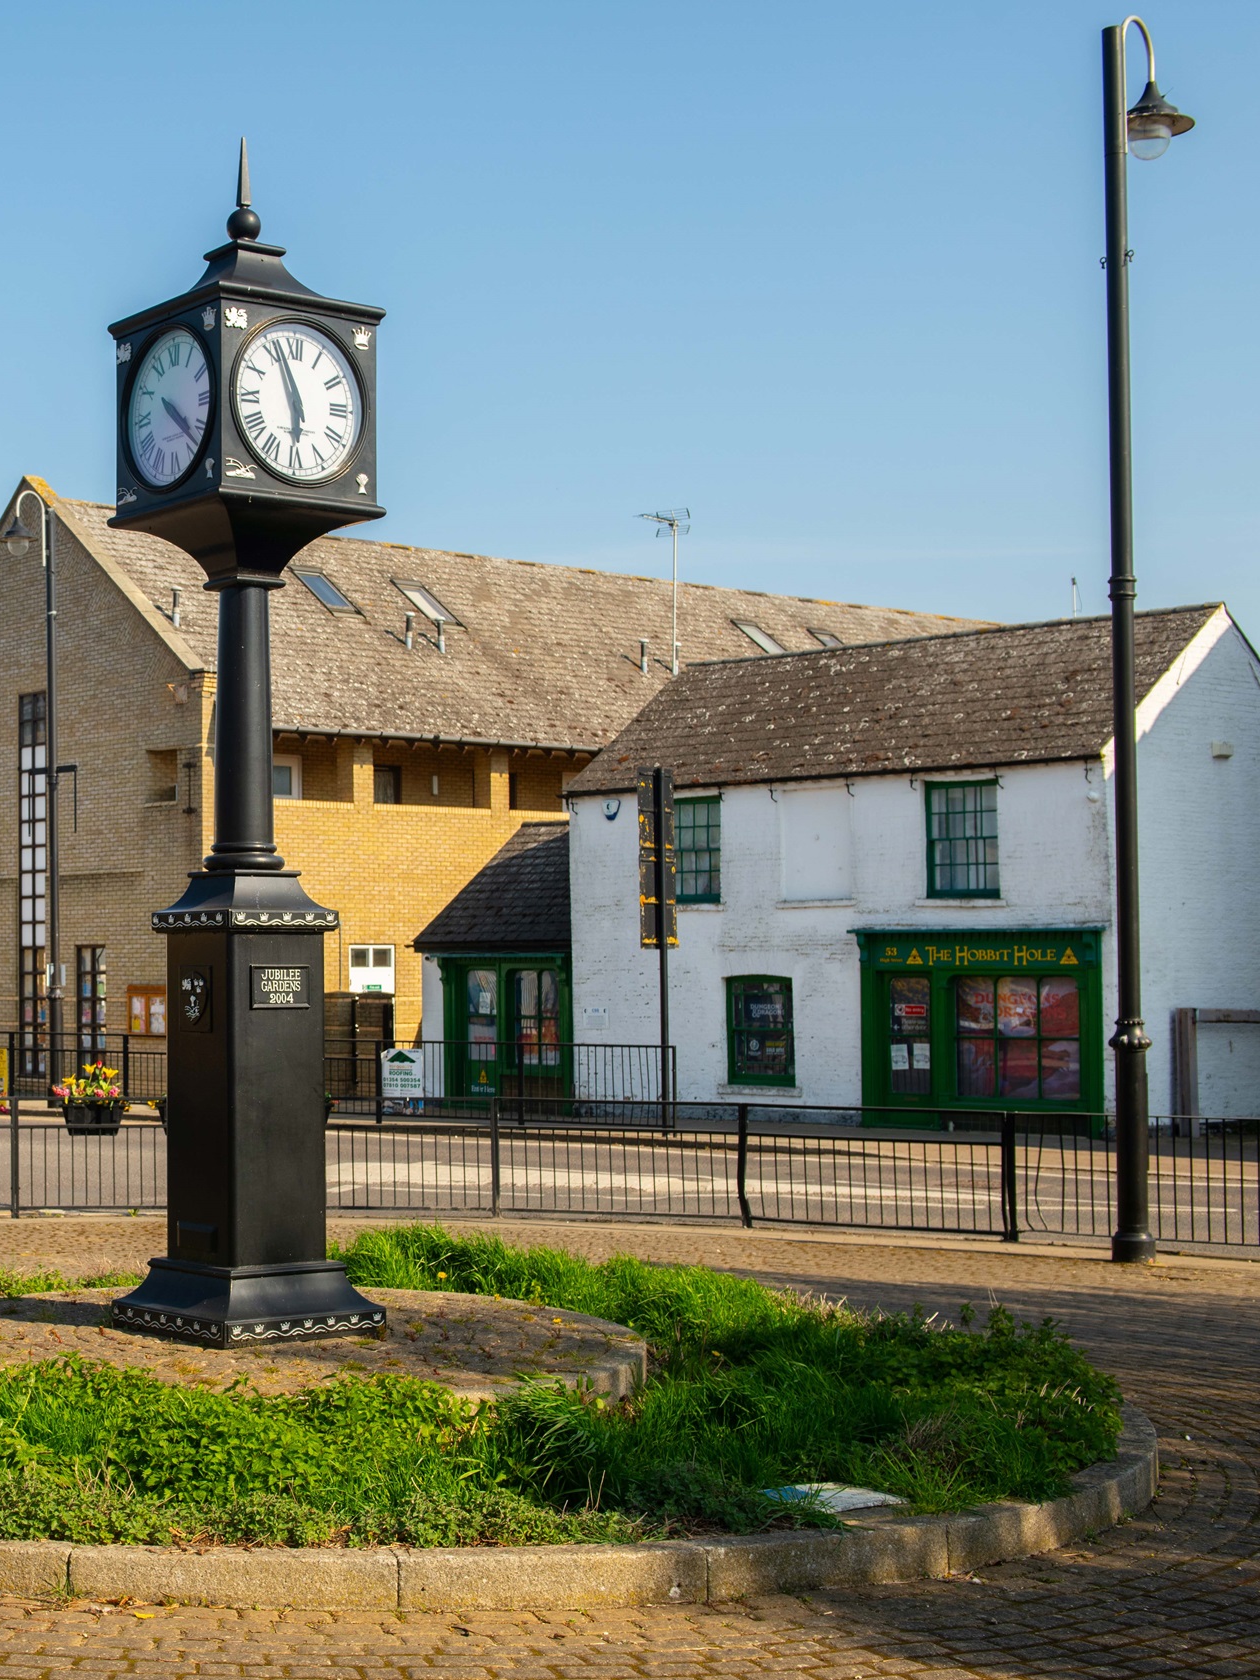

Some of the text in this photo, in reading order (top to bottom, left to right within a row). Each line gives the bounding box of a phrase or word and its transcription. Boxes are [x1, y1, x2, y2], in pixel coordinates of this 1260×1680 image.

[885, 947, 897, 957] 53
[260, 968, 302, 980] JUBILEE
[260, 980, 302, 992] GARDENS
[269, 992, 294, 1004] 2004
[471, 1084, 484, 1093] Entr
